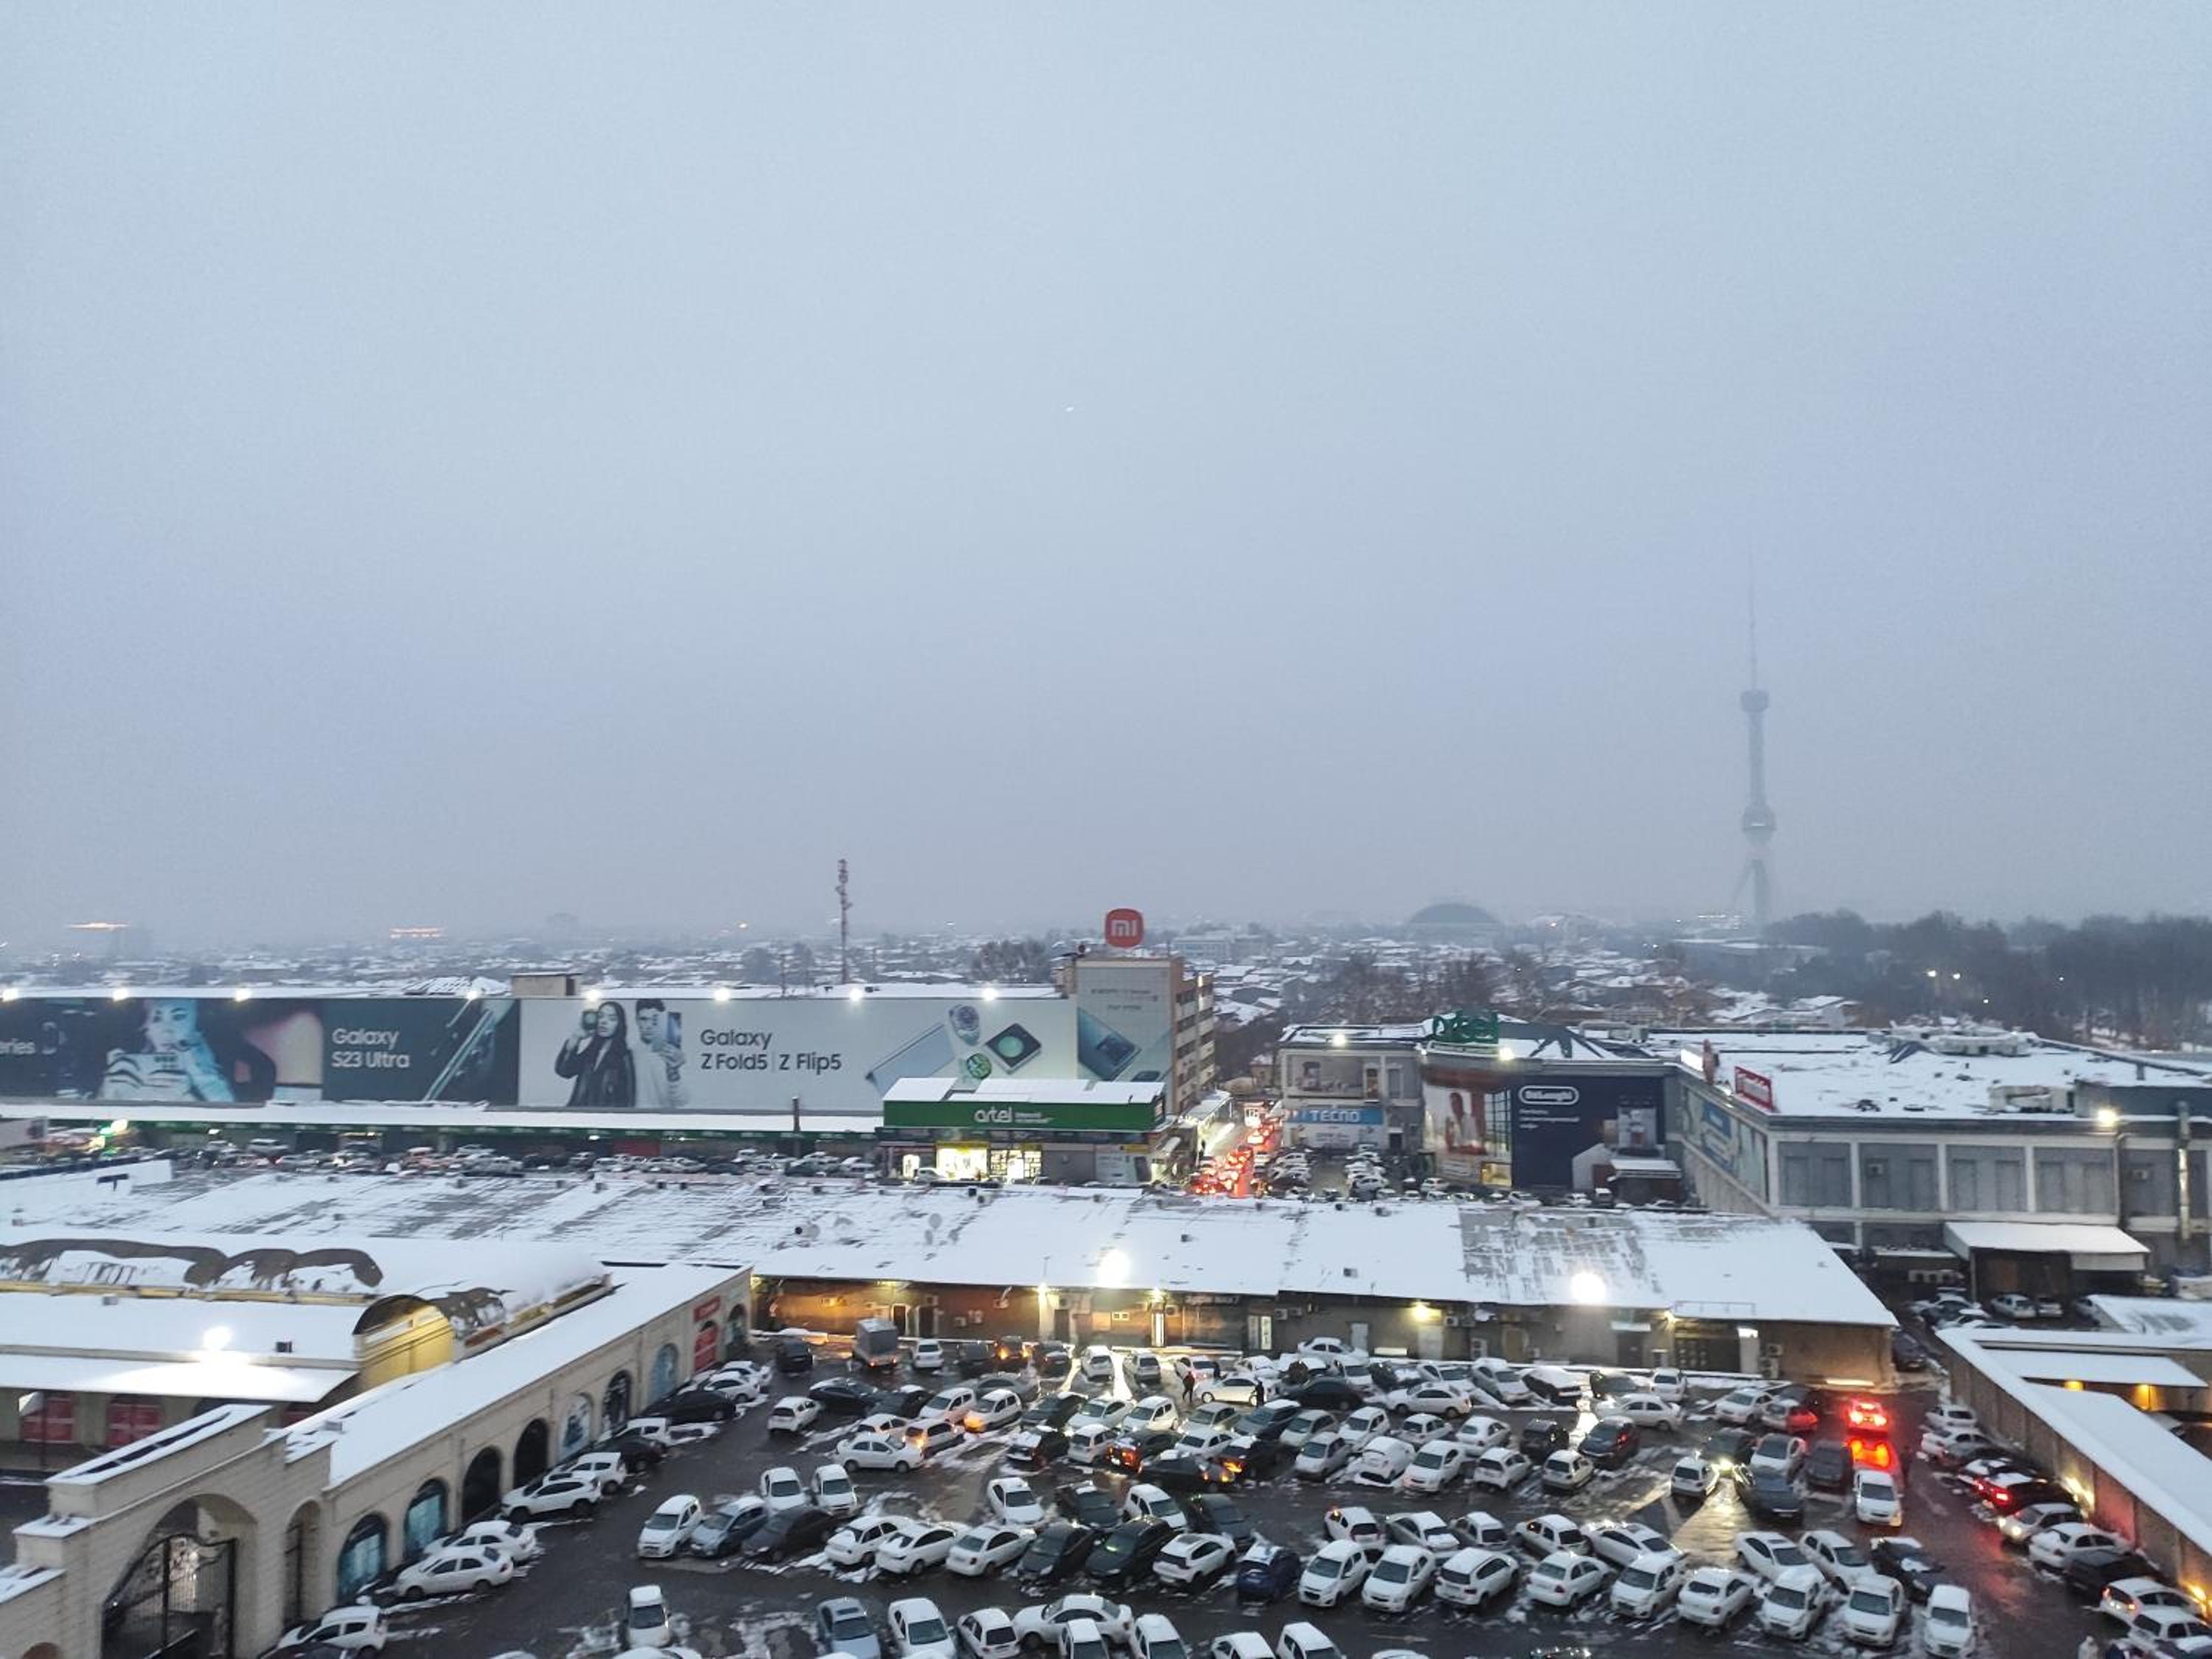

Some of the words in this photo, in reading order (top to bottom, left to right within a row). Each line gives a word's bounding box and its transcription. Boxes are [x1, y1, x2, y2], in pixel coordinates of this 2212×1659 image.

[332, 1028, 399, 1050] Galaxy
[700, 1029, 773, 1050] Galaxy
[332, 1051, 362, 1068] S23
[365, 1051, 410, 1068] Ultra
[701, 1053, 712, 1070] Z
[716, 1053, 768, 1070] Fold5
[779, 1053, 790, 1070] Z
[797, 1051, 842, 1075] Flip5
[974, 1106, 1013, 1123] artel
